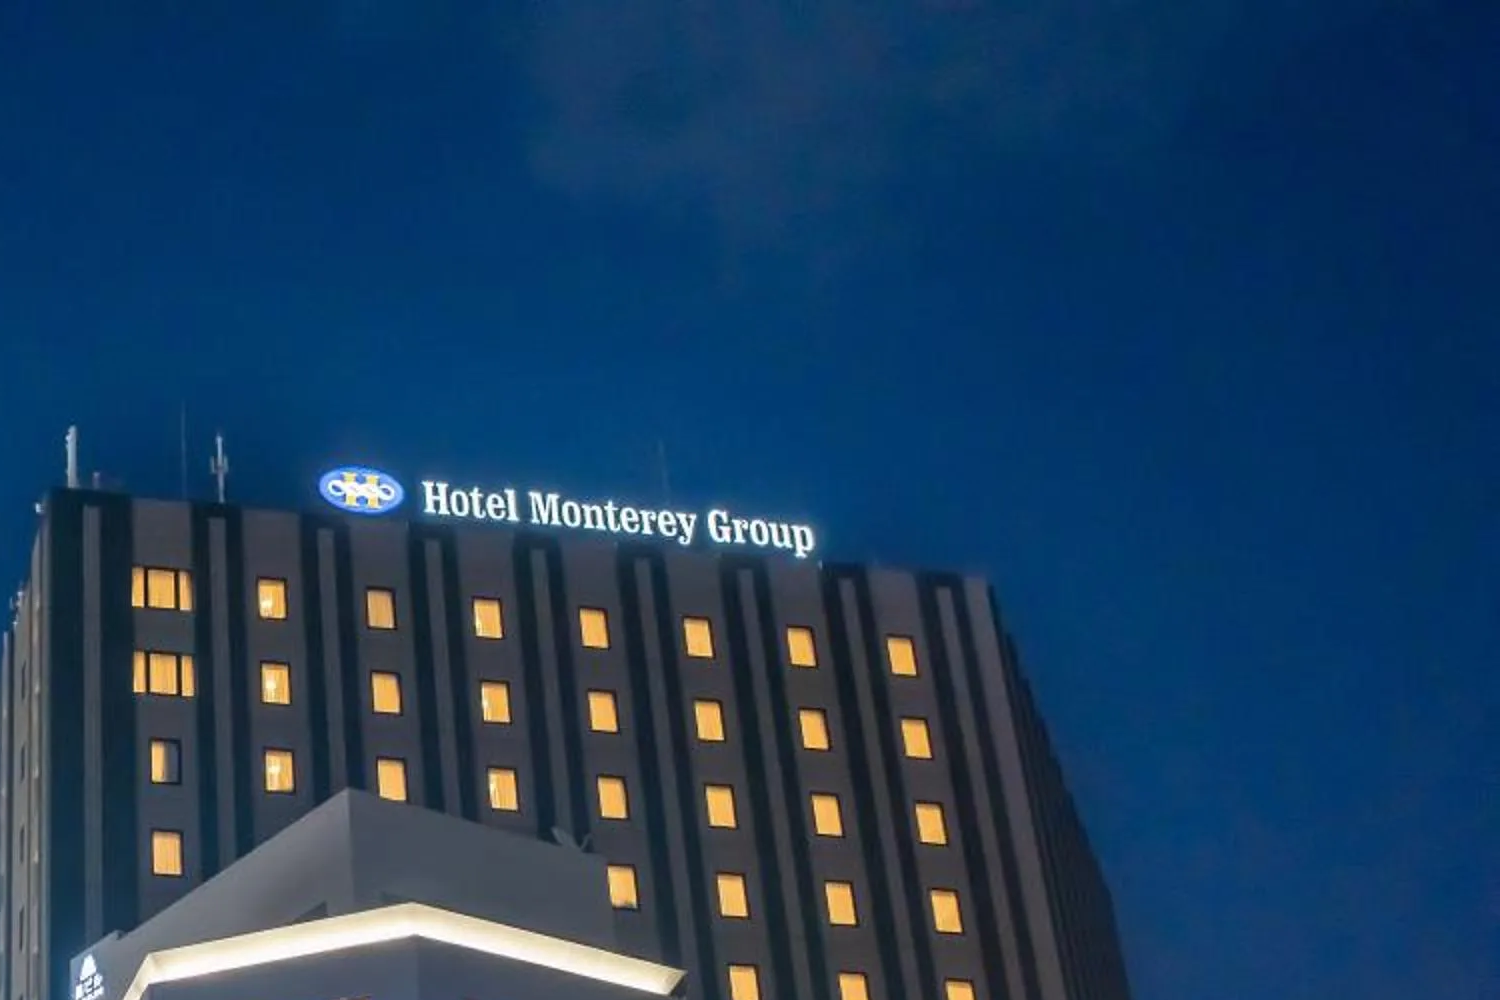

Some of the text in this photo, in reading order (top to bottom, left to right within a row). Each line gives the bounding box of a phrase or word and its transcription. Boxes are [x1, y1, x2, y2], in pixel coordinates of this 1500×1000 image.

[421, 480, 816, 558] Hotel Monterey Group
